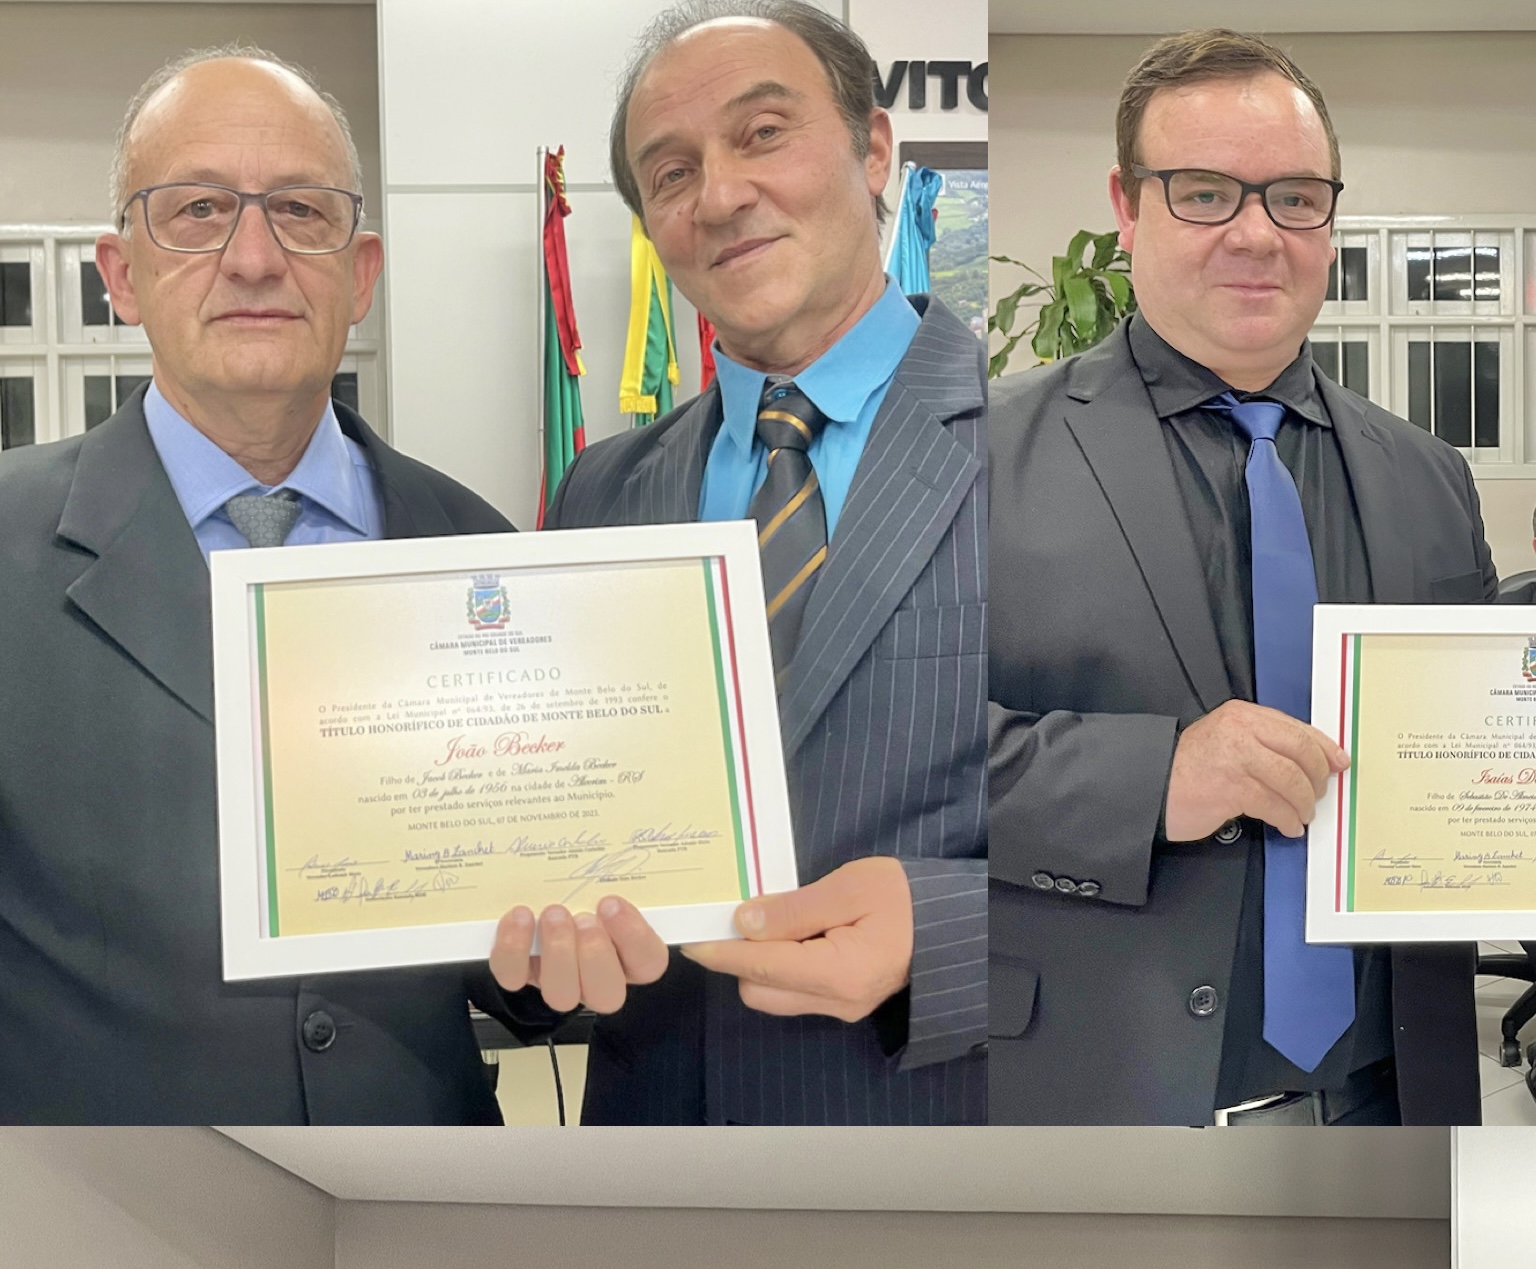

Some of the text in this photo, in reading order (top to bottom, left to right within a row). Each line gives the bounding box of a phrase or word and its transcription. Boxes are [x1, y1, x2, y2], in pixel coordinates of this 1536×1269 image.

[430, 641, 459, 651] CÂMARA
[461, 639, 497, 648] MUNICIPAL
[499, 638, 507, 646] DE
[510, 635, 552, 646] VEREADORES
[426, 667, 561, 689] CERTIFICADO
[319, 724, 365, 738] TÍTULO
[368, 719, 444, 735] HONORÍFICO
[447, 718, 463, 728] DE
[466, 713, 519, 727] CIDADÃO
[522, 713, 538, 722] DE
[541, 710, 583, 722] MONTE
[586, 708, 617, 719] BELO
[621, 707, 637, 716] DO
[640, 705, 663, 715] SUL
[434, 731, 566, 766] João Becker
[1397, 750, 1433, 759] TÍTULO
[1436, 750, 1496, 759] HONORÍFICO
[1498, 751, 1511, 759] DE
[391, 806, 406, 816] por
[409, 804, 421, 813] ter
[425, 801, 464, 815] prestado
[466, 799, 503, 811] serviços
[505, 794, 550, 806] relevantes
[567, 790, 615, 802] Município.
[408, 822, 437, 830] MONTE
[520, 812, 567, 822] NOVEMBRO
[570, 811, 580, 819] DE
